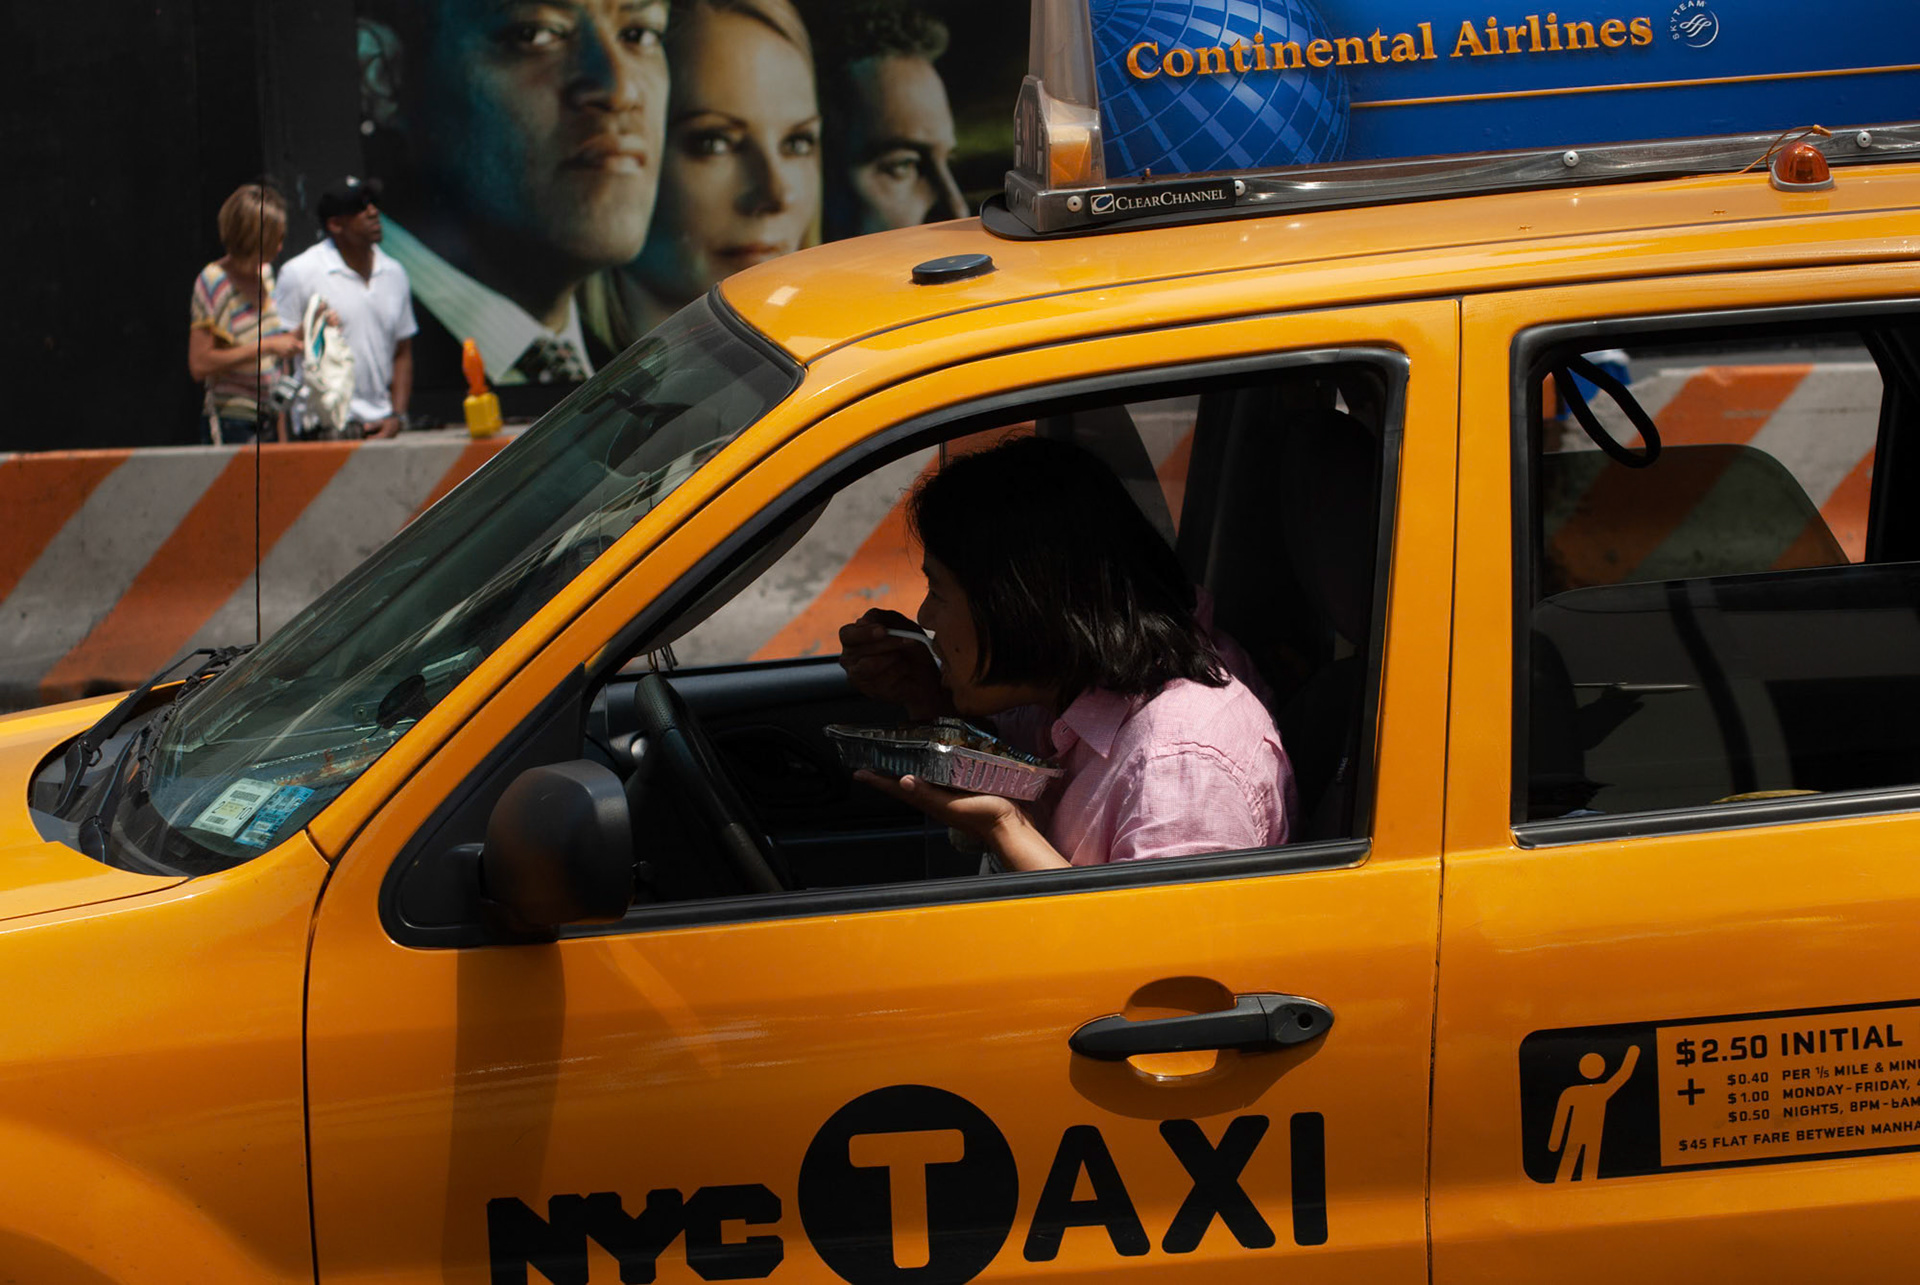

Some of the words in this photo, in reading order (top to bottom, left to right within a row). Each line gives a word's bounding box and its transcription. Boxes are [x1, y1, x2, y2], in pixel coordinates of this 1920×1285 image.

[1670, 0, 1706, 40] SKYTEAM
[1126, 22, 1437, 79] Continental
[1450, 12, 1653, 57] Airlines
[1676, 1034, 1768, 1067] $2.50
[1781, 1024, 1903, 1056] INITIAL
[1727, 1072, 1769, 1086] $0.40
[1782, 1068, 1811, 1080] PER
[1834, 1063, 1869, 1076] MILE
[1874, 1062, 1884, 1074] &
[1728, 1090, 1770, 1104] $1.00
[1728, 1109, 1771, 1123] $0.50
[1783, 1102, 1844, 1118] NIGHTS,
[1678, 1139, 1707, 1152] $45
[1712, 1134, 1748, 1148] FLAT
[1753, 1131, 1791, 1145] FARE
[1796, 1125, 1865, 1141] BETWEEN
[487, 1184, 784, 1285] NYC
[849, 1111, 1328, 1270] TAXI
